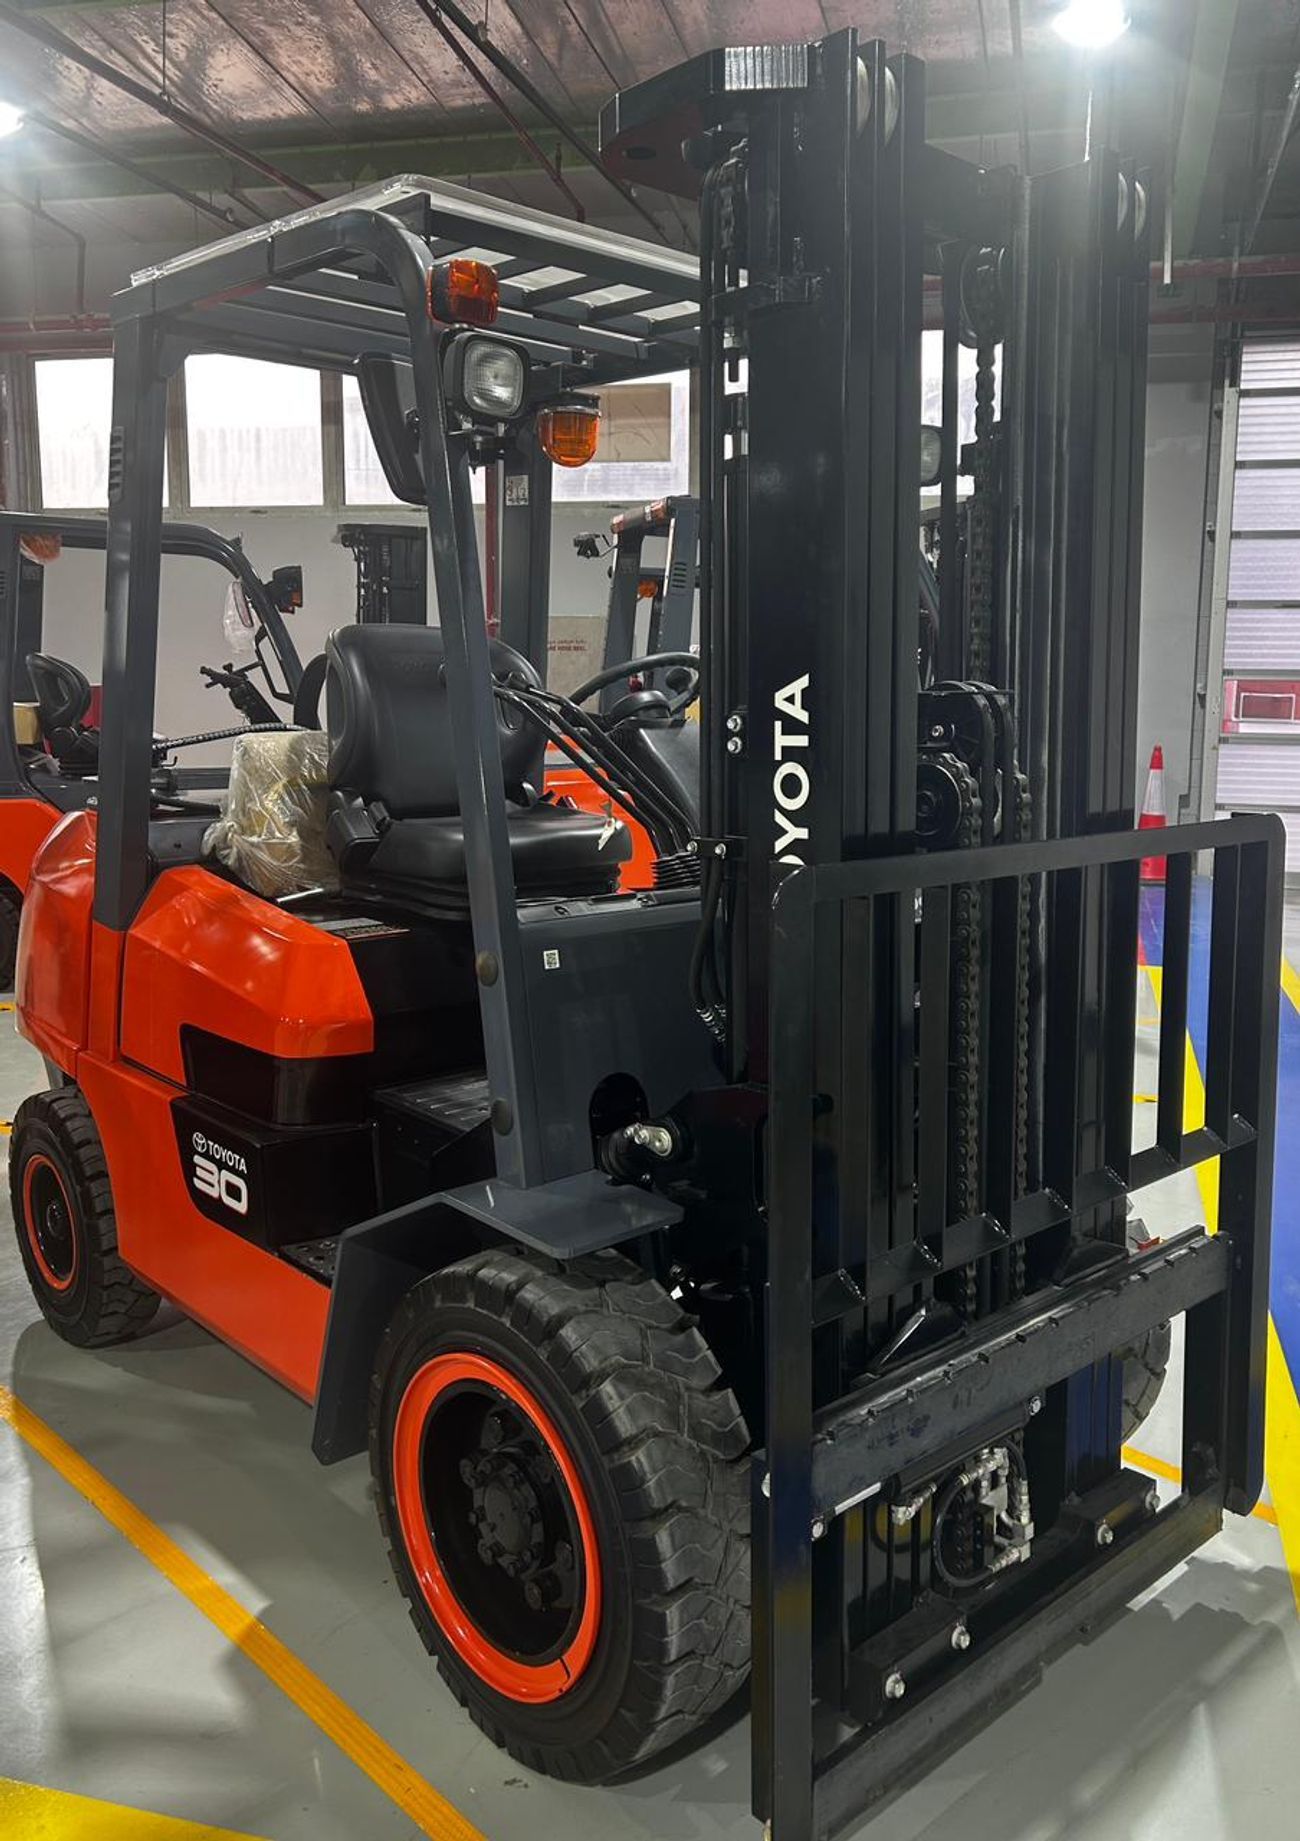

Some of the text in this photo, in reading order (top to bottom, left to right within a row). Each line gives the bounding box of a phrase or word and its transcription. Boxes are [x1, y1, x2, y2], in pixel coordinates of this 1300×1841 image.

[773, 673, 810, 866] YOTA
[193, 1154, 248, 1215] 30
[207, 1140, 247, 1174] TOYOTA
